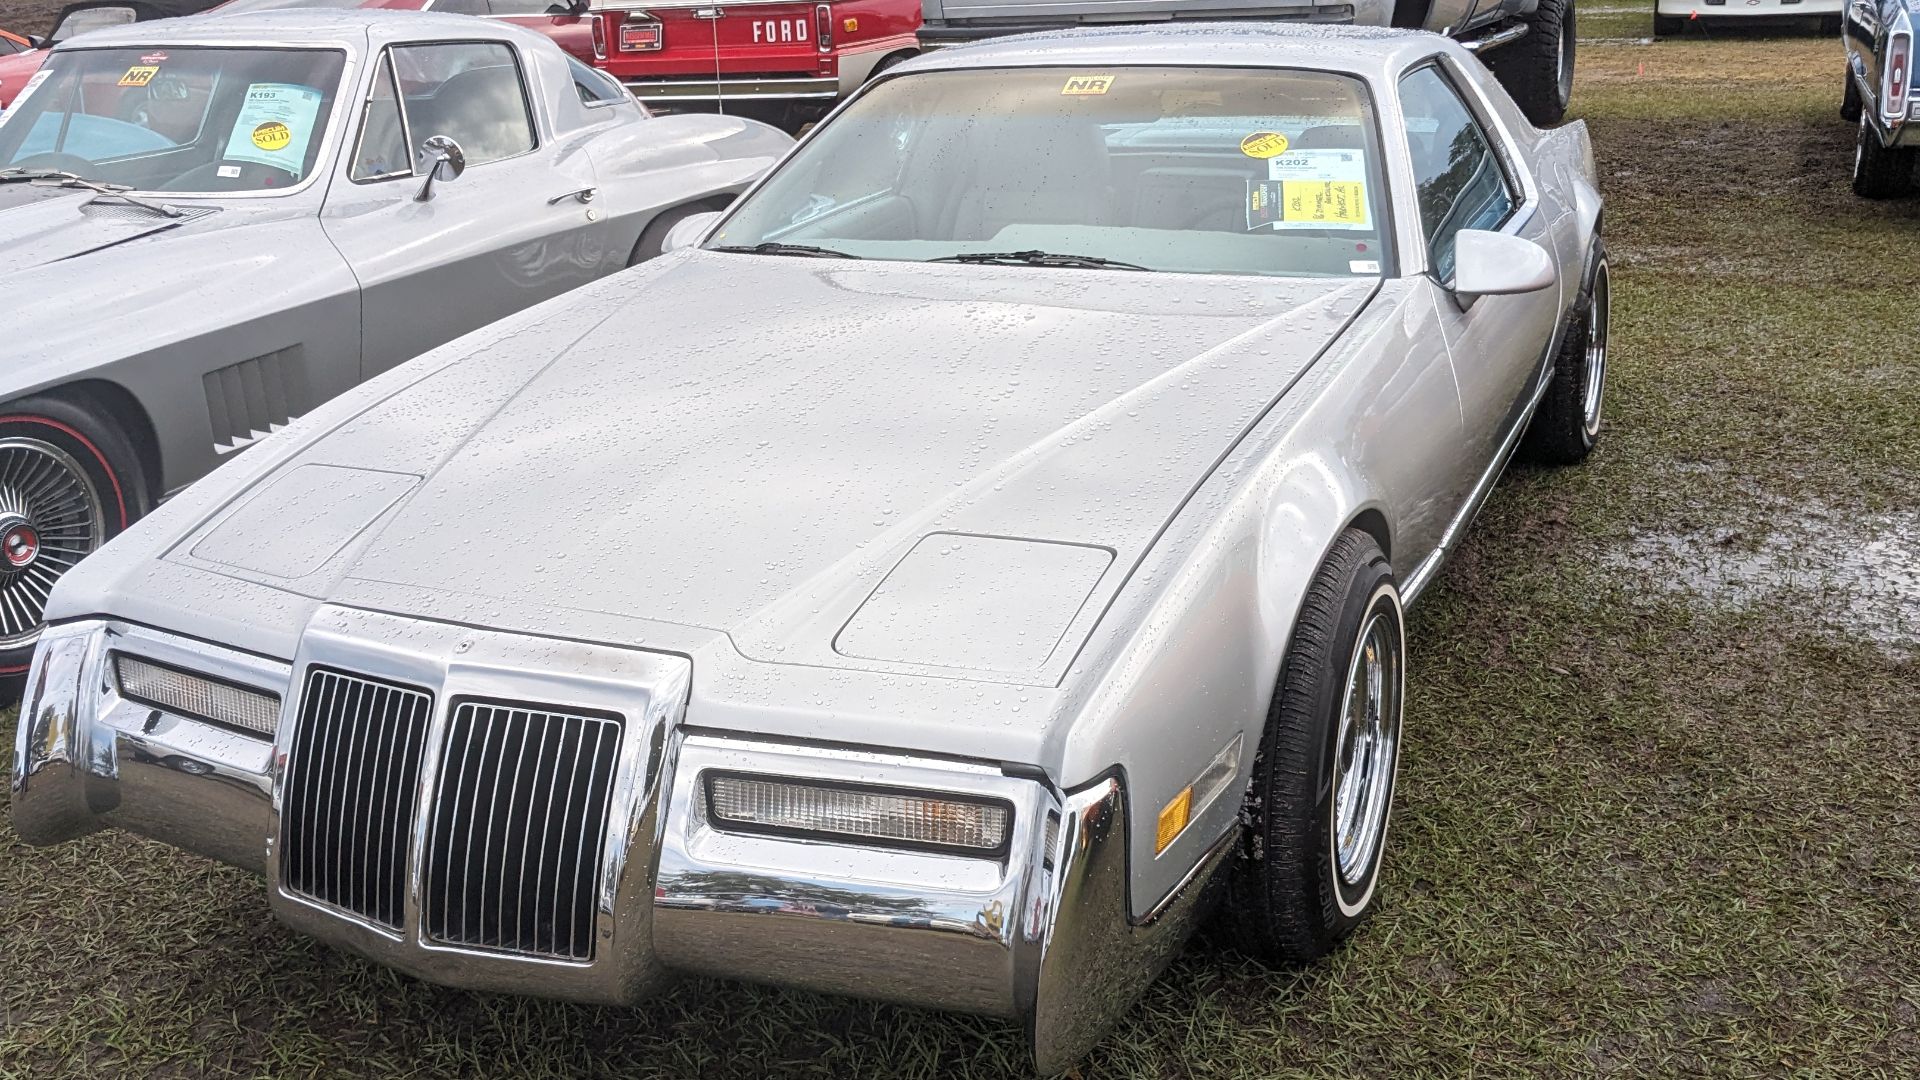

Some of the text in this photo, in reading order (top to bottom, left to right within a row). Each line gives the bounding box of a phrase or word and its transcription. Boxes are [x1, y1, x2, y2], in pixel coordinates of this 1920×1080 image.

[752, 20, 807, 43] FORD
[123, 70, 153, 82] NR
[1067, 80, 1107, 90] NR
[255, 131, 289, 144] SOLD
[1248, 138, 1285, 155] SOLD
